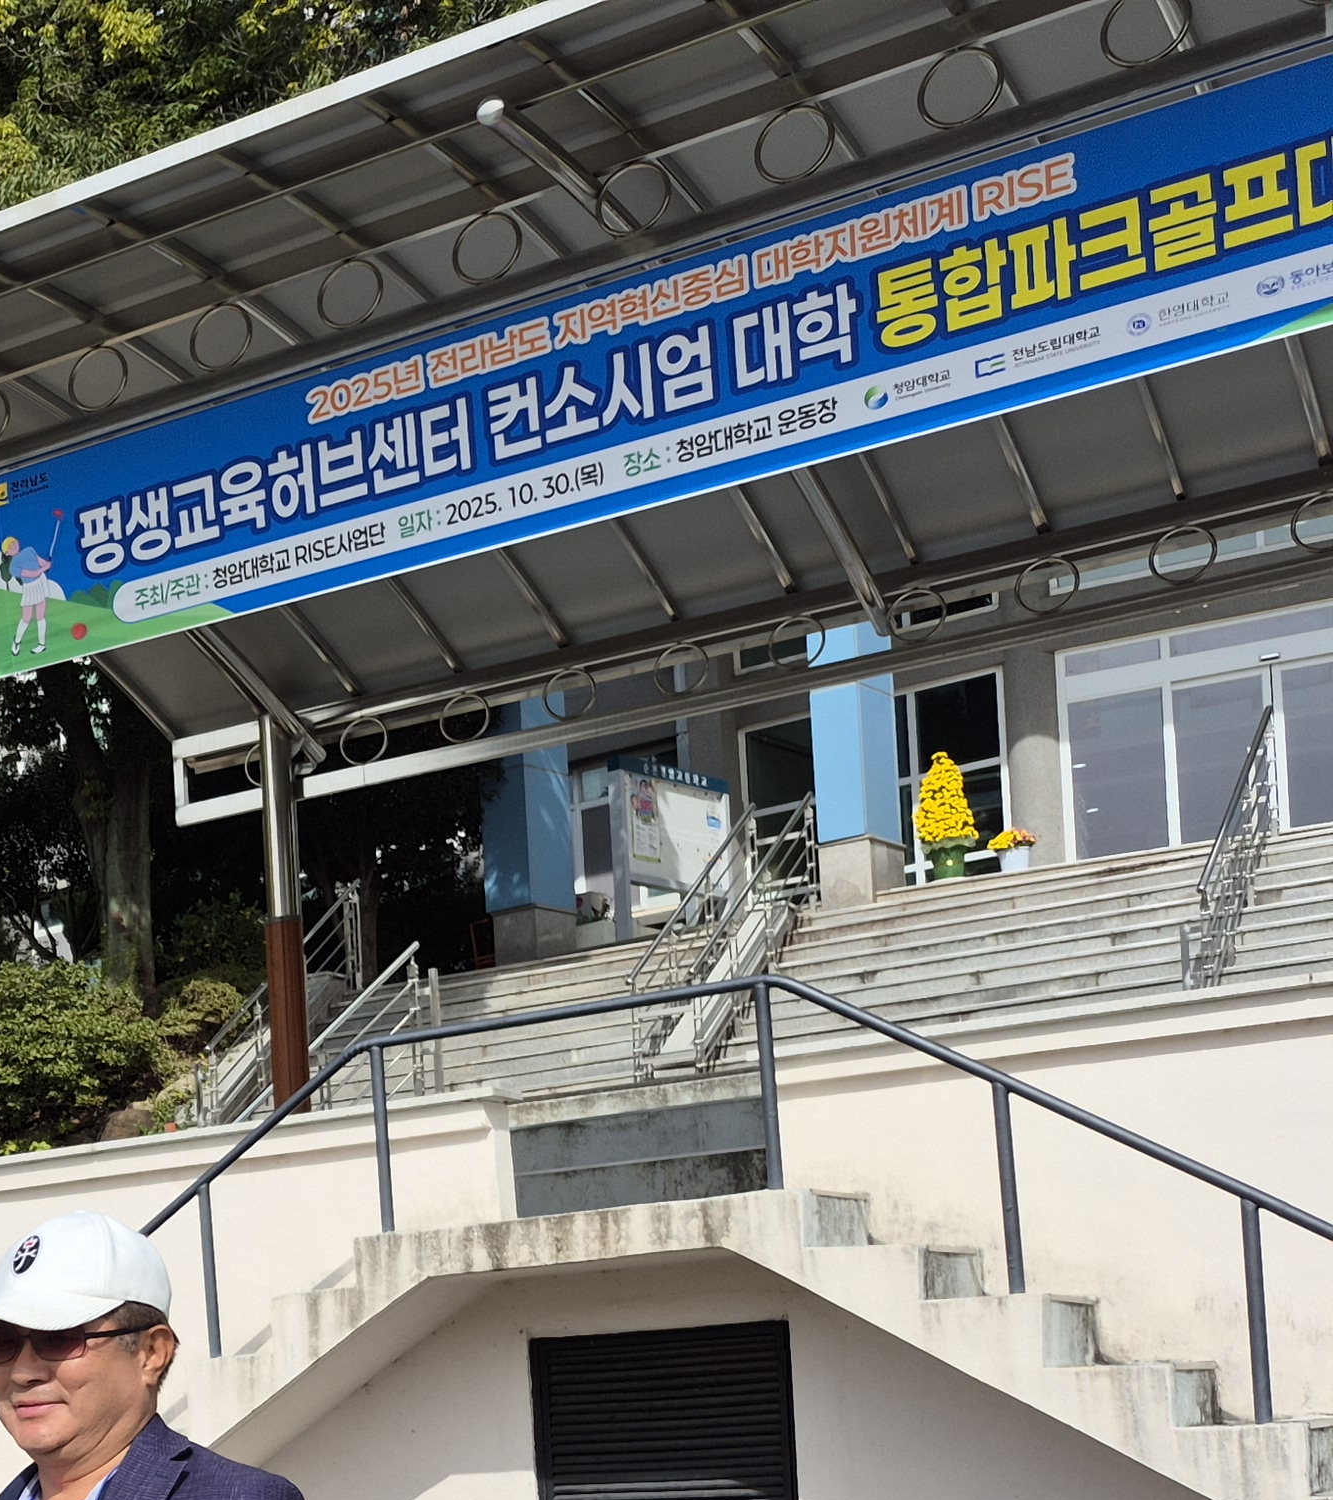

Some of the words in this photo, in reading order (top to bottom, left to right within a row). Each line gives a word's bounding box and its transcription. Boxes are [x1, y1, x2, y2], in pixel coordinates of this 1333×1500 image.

[308, 357, 422, 421] 2025년
[430, 328, 549, 384] 전라남도
[557, 260, 744, 345] 지역혁신중심
[756, 190, 964, 282] 대학지원체계
[976, 157, 1072, 217] RISE
[1012, 326, 1101, 361] 전남도립대학교
[1158, 291, 1229, 321] 한영대학교
[79, 397, 471, 574] 평생교육허브센터
[488, 325, 714, 460] 컨소시엄
[733, 283, 856, 388] 대학
[892, 369, 952, 395] 청암대학교
[212, 549, 291, 589] 청암대학교
[294, 521, 386, 567] RISE사업단
[676, 415, 773, 463] 청암대학교
[777, 396, 838, 437] 운동장
